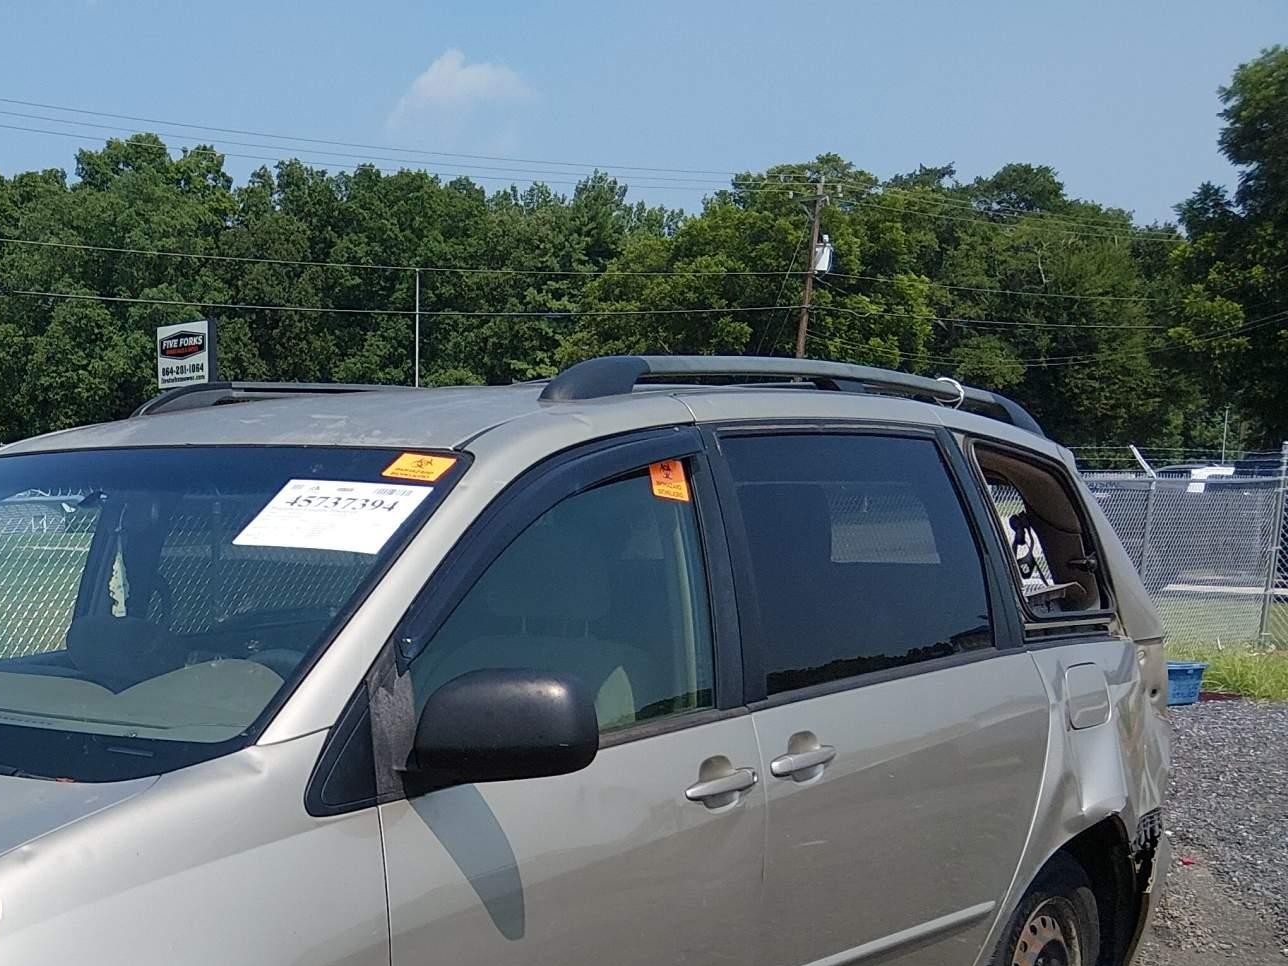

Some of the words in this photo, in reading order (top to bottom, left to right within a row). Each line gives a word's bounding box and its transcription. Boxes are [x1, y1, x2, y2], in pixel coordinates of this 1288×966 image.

[163, 338, 179, 350] FIVE
[179, 335, 203, 347] FORKS
[285, 495, 400, 513] 45737394
